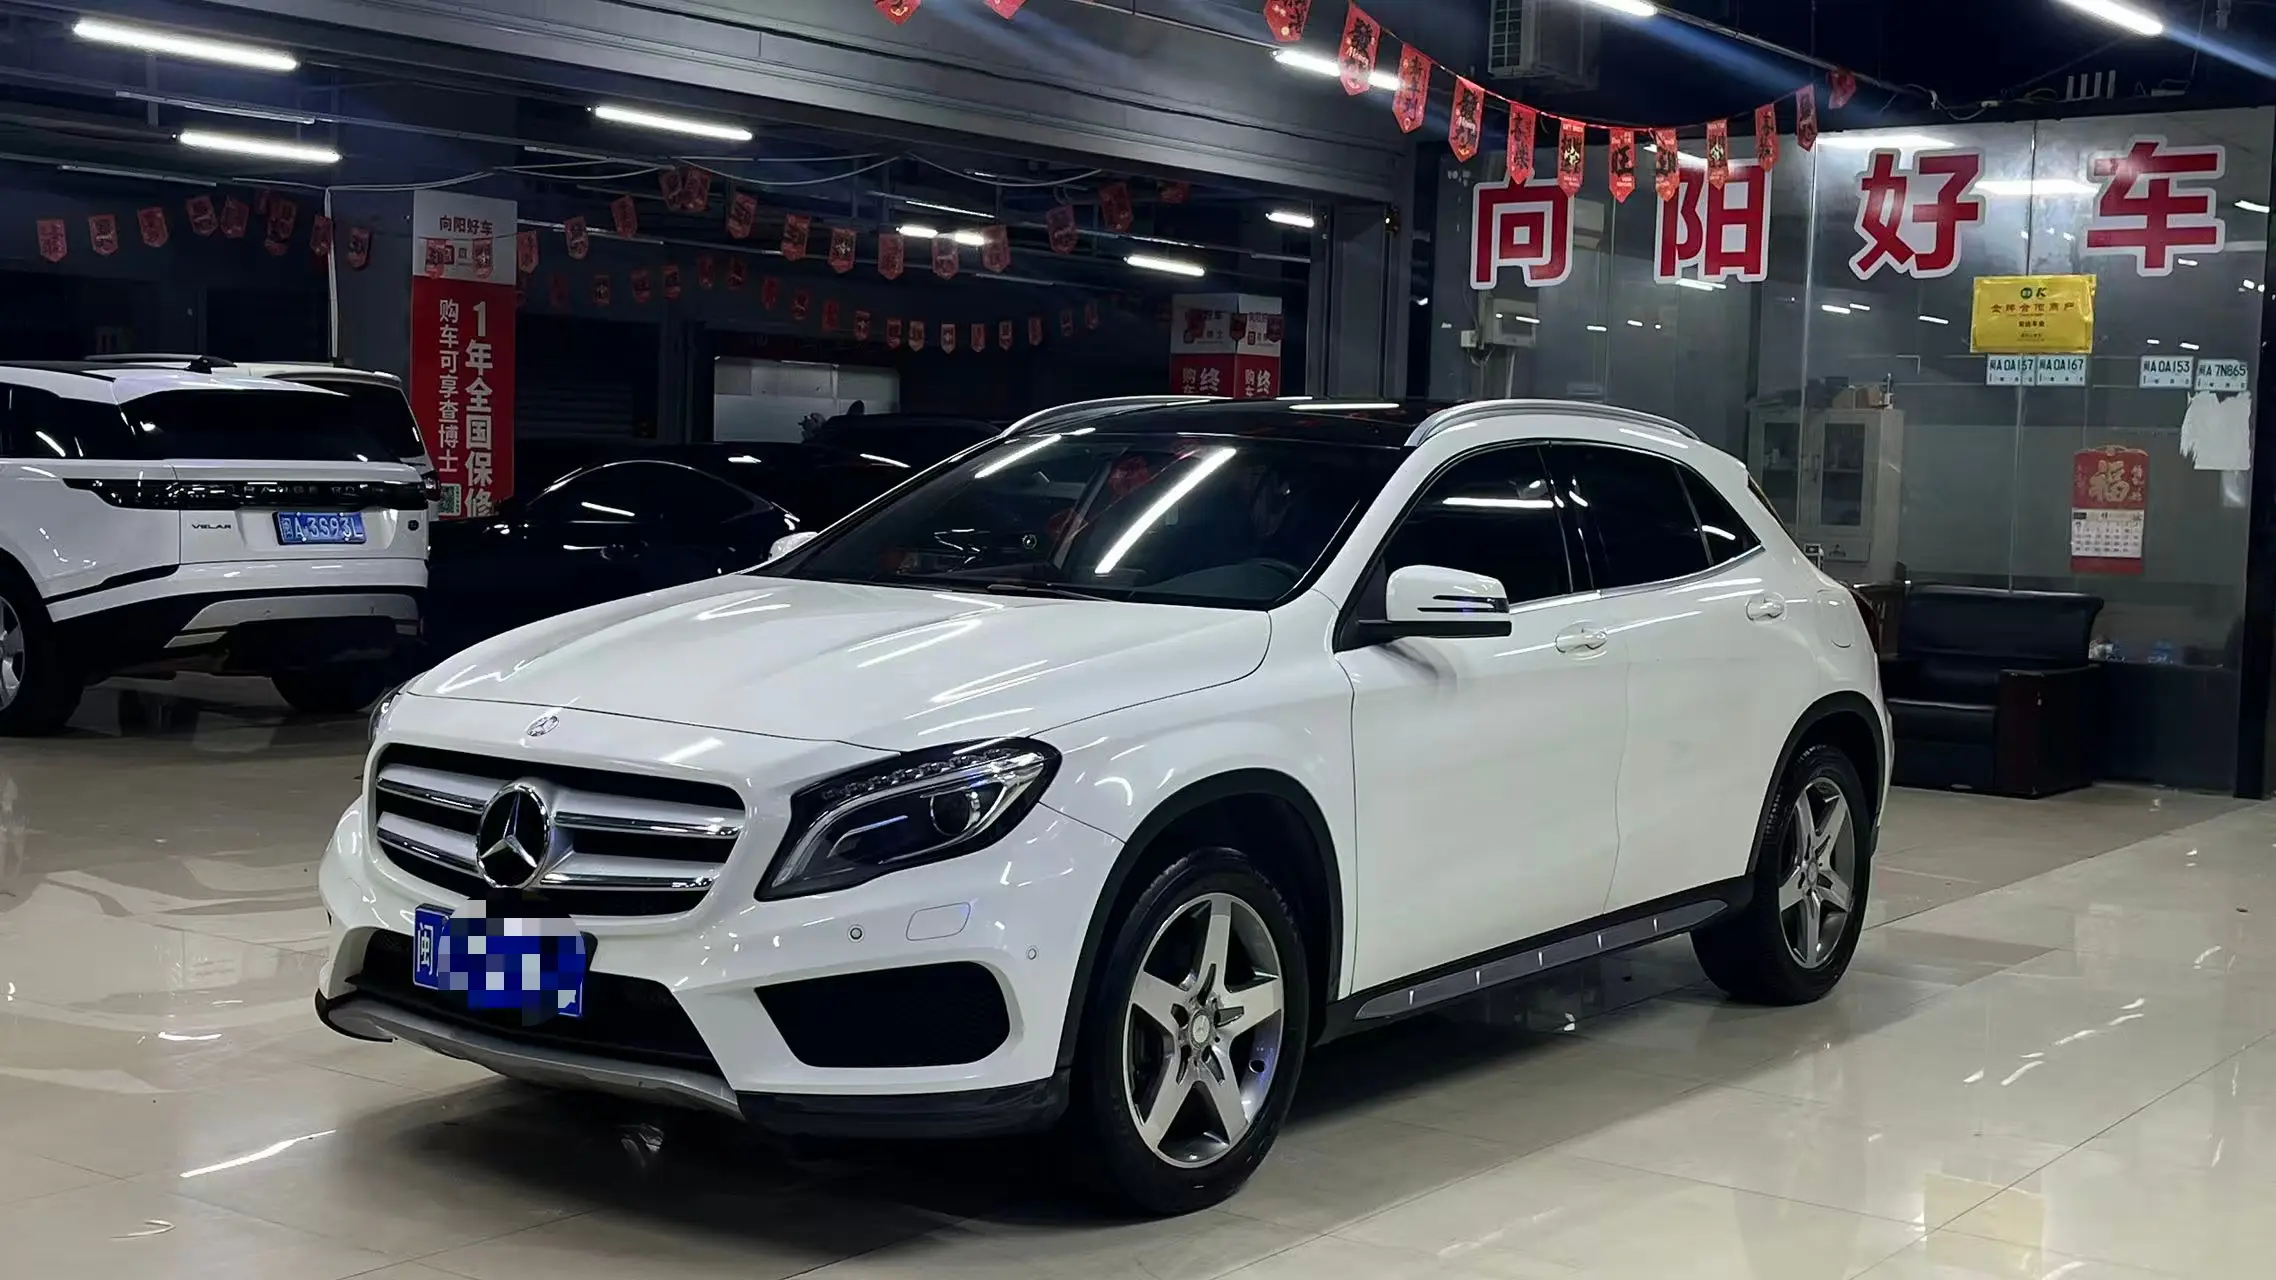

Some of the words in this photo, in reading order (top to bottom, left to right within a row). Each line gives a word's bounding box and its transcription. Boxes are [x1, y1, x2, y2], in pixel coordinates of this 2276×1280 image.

[439, 215, 493, 235] 向阳好车
[1472, 135, 2224, 288] 向阳好车
[438, 299, 459, 473] 购车可享查博士
[465, 300, 494, 517] 1年全国保修
[2089, 460, 2130, 501] 福
